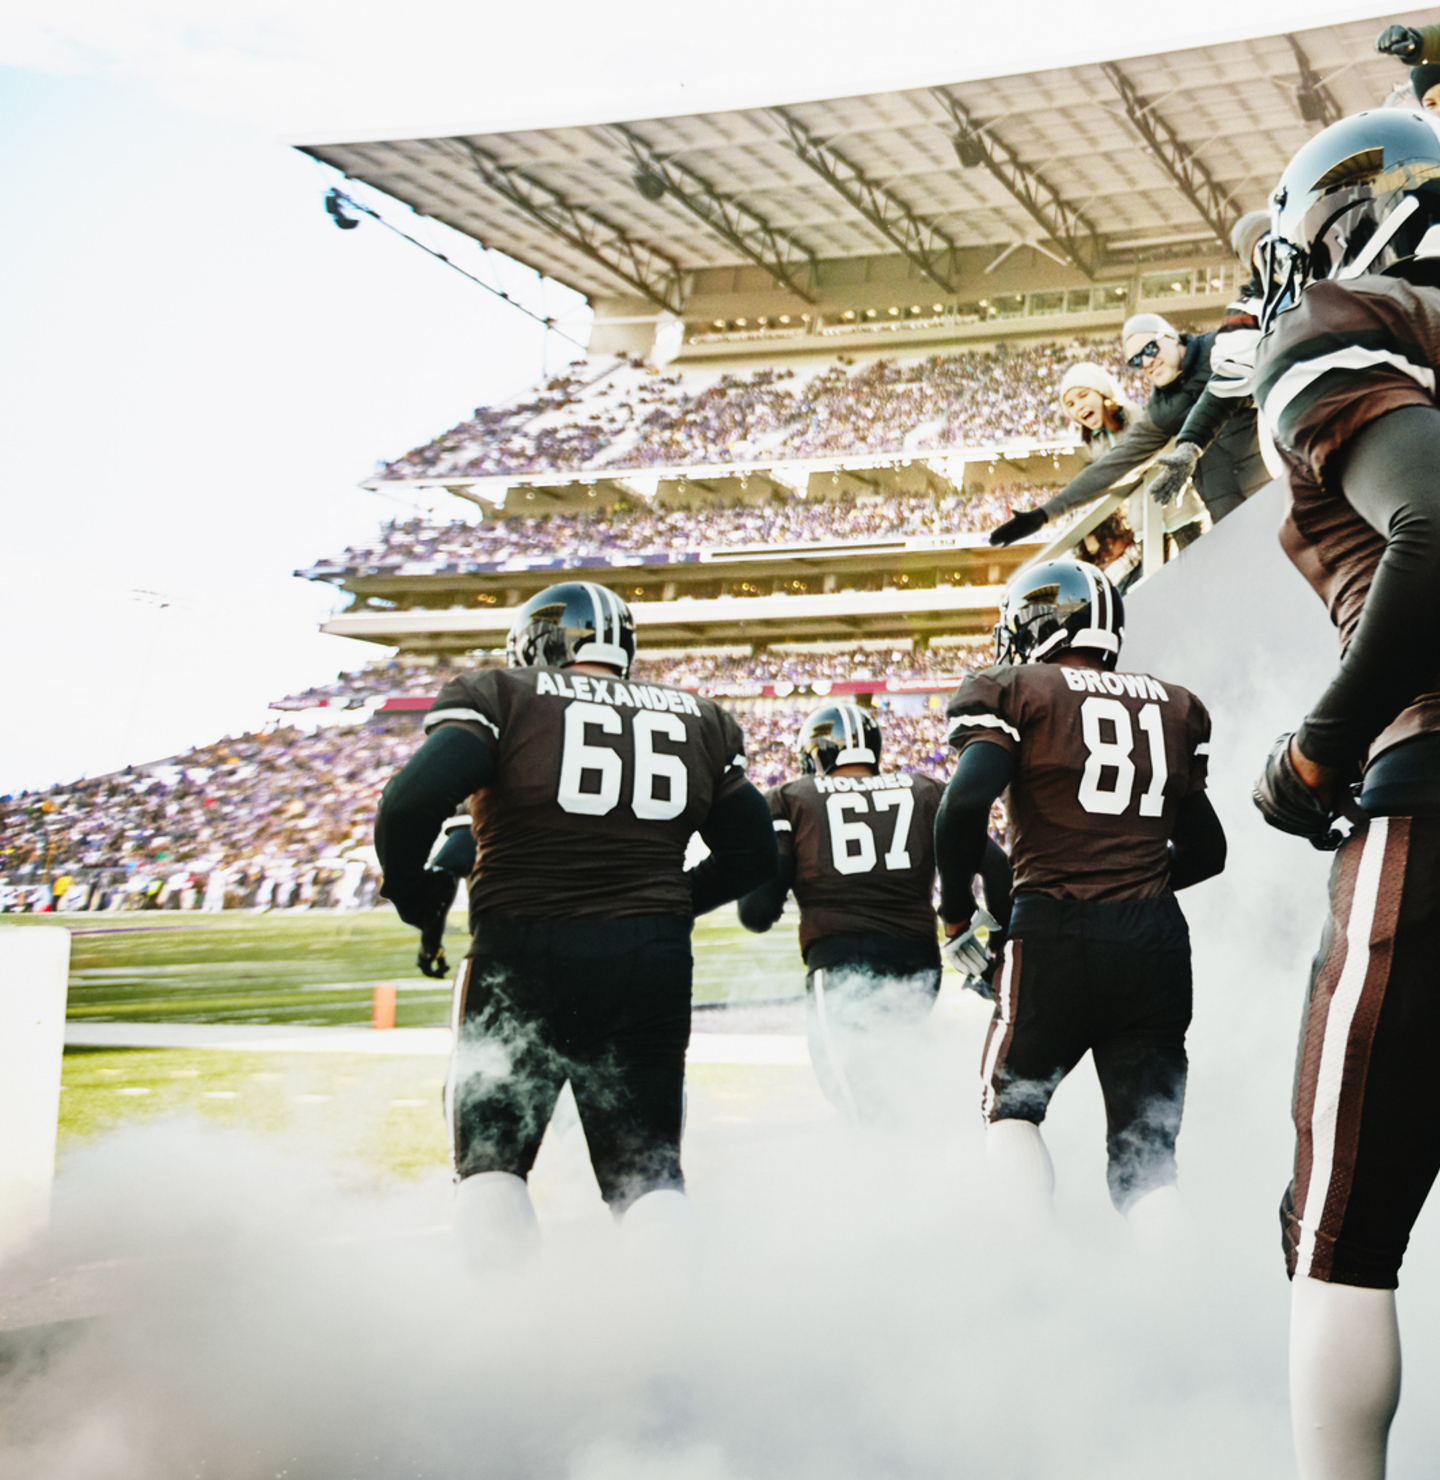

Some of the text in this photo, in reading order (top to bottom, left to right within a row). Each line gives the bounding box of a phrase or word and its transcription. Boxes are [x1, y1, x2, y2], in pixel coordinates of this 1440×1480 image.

[536, 672, 701, 717] ALEXANDER
[1060, 667, 1169, 702] BROWN
[557, 700, 688, 820] 66
[814, 773, 914, 793] HOLMES
[1078, 696, 1168, 817] 81
[826, 788, 915, 875] 67
